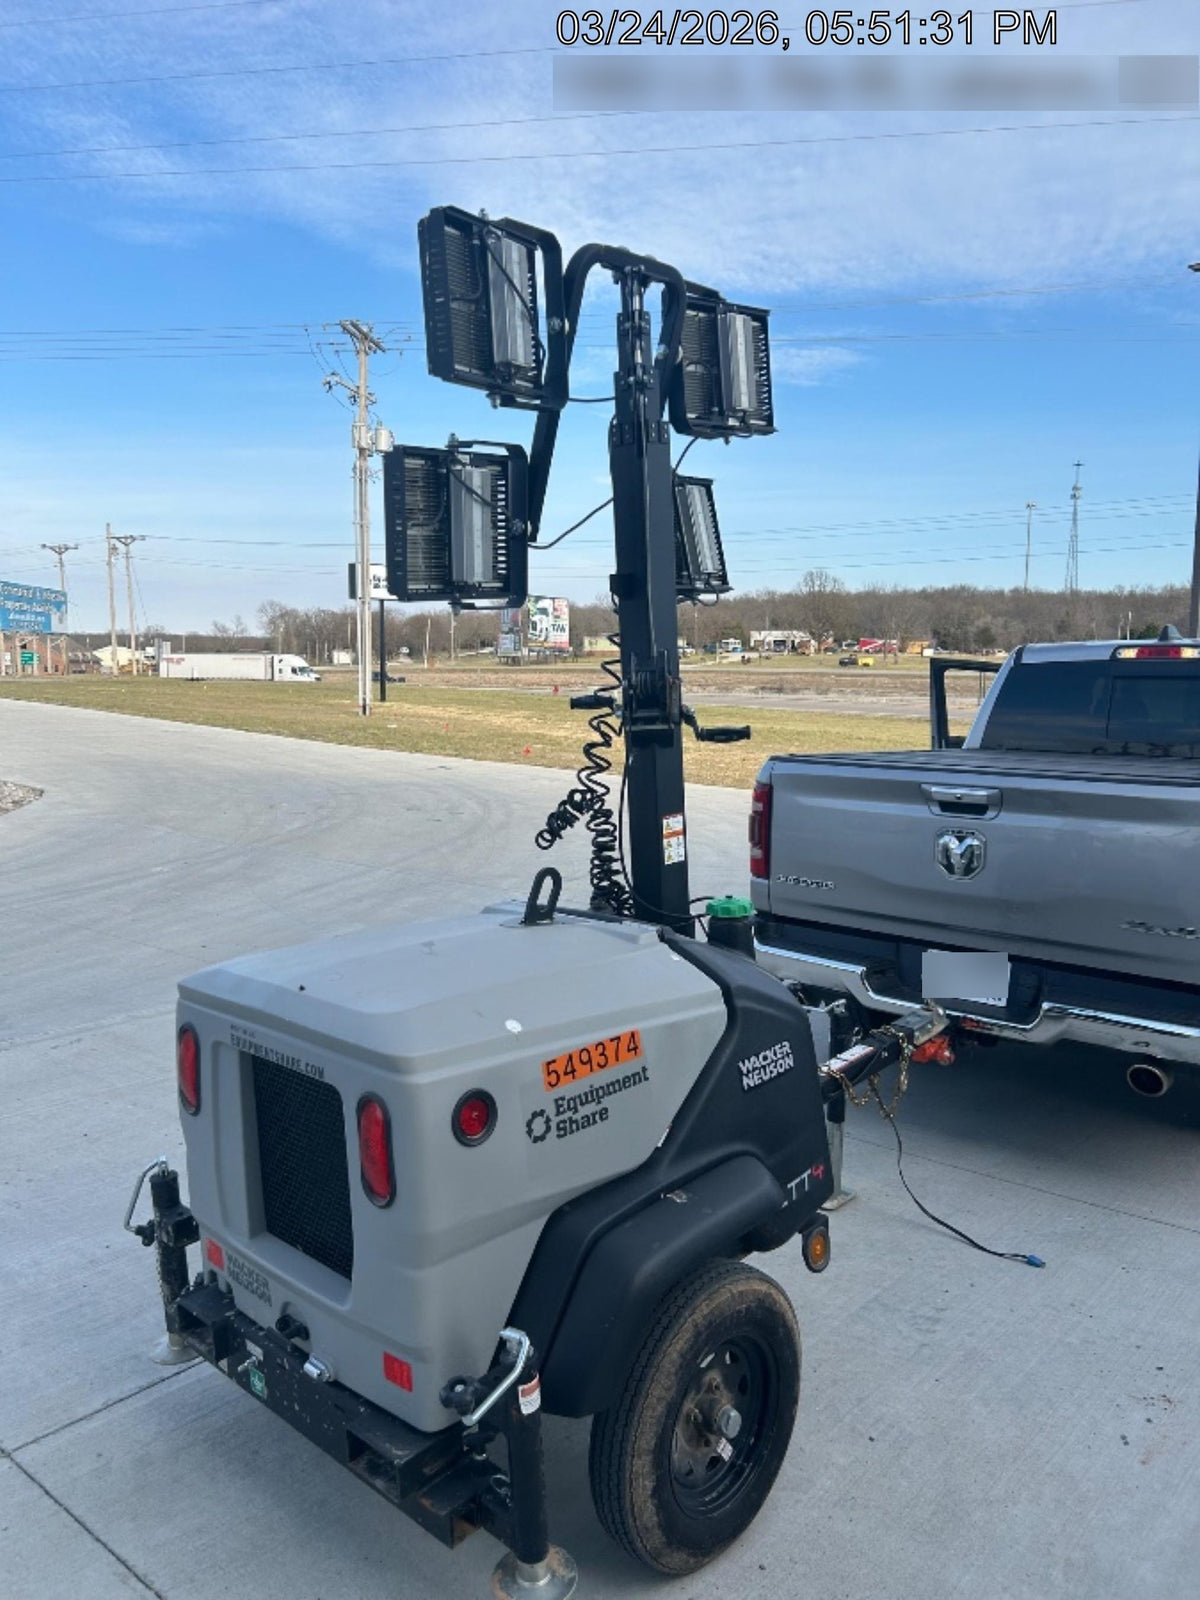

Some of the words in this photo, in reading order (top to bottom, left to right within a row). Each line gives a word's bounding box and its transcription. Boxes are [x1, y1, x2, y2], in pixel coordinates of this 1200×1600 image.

[544, 1030, 640, 1088] 549374
[737, 1041, 792, 1075] WACKER
[741, 1053, 795, 1092] NEUSON
[553, 1065, 650, 1117] Equipment
[555, 1106, 609, 1139] Share
[781, 1165, 825, 1209] TT4
